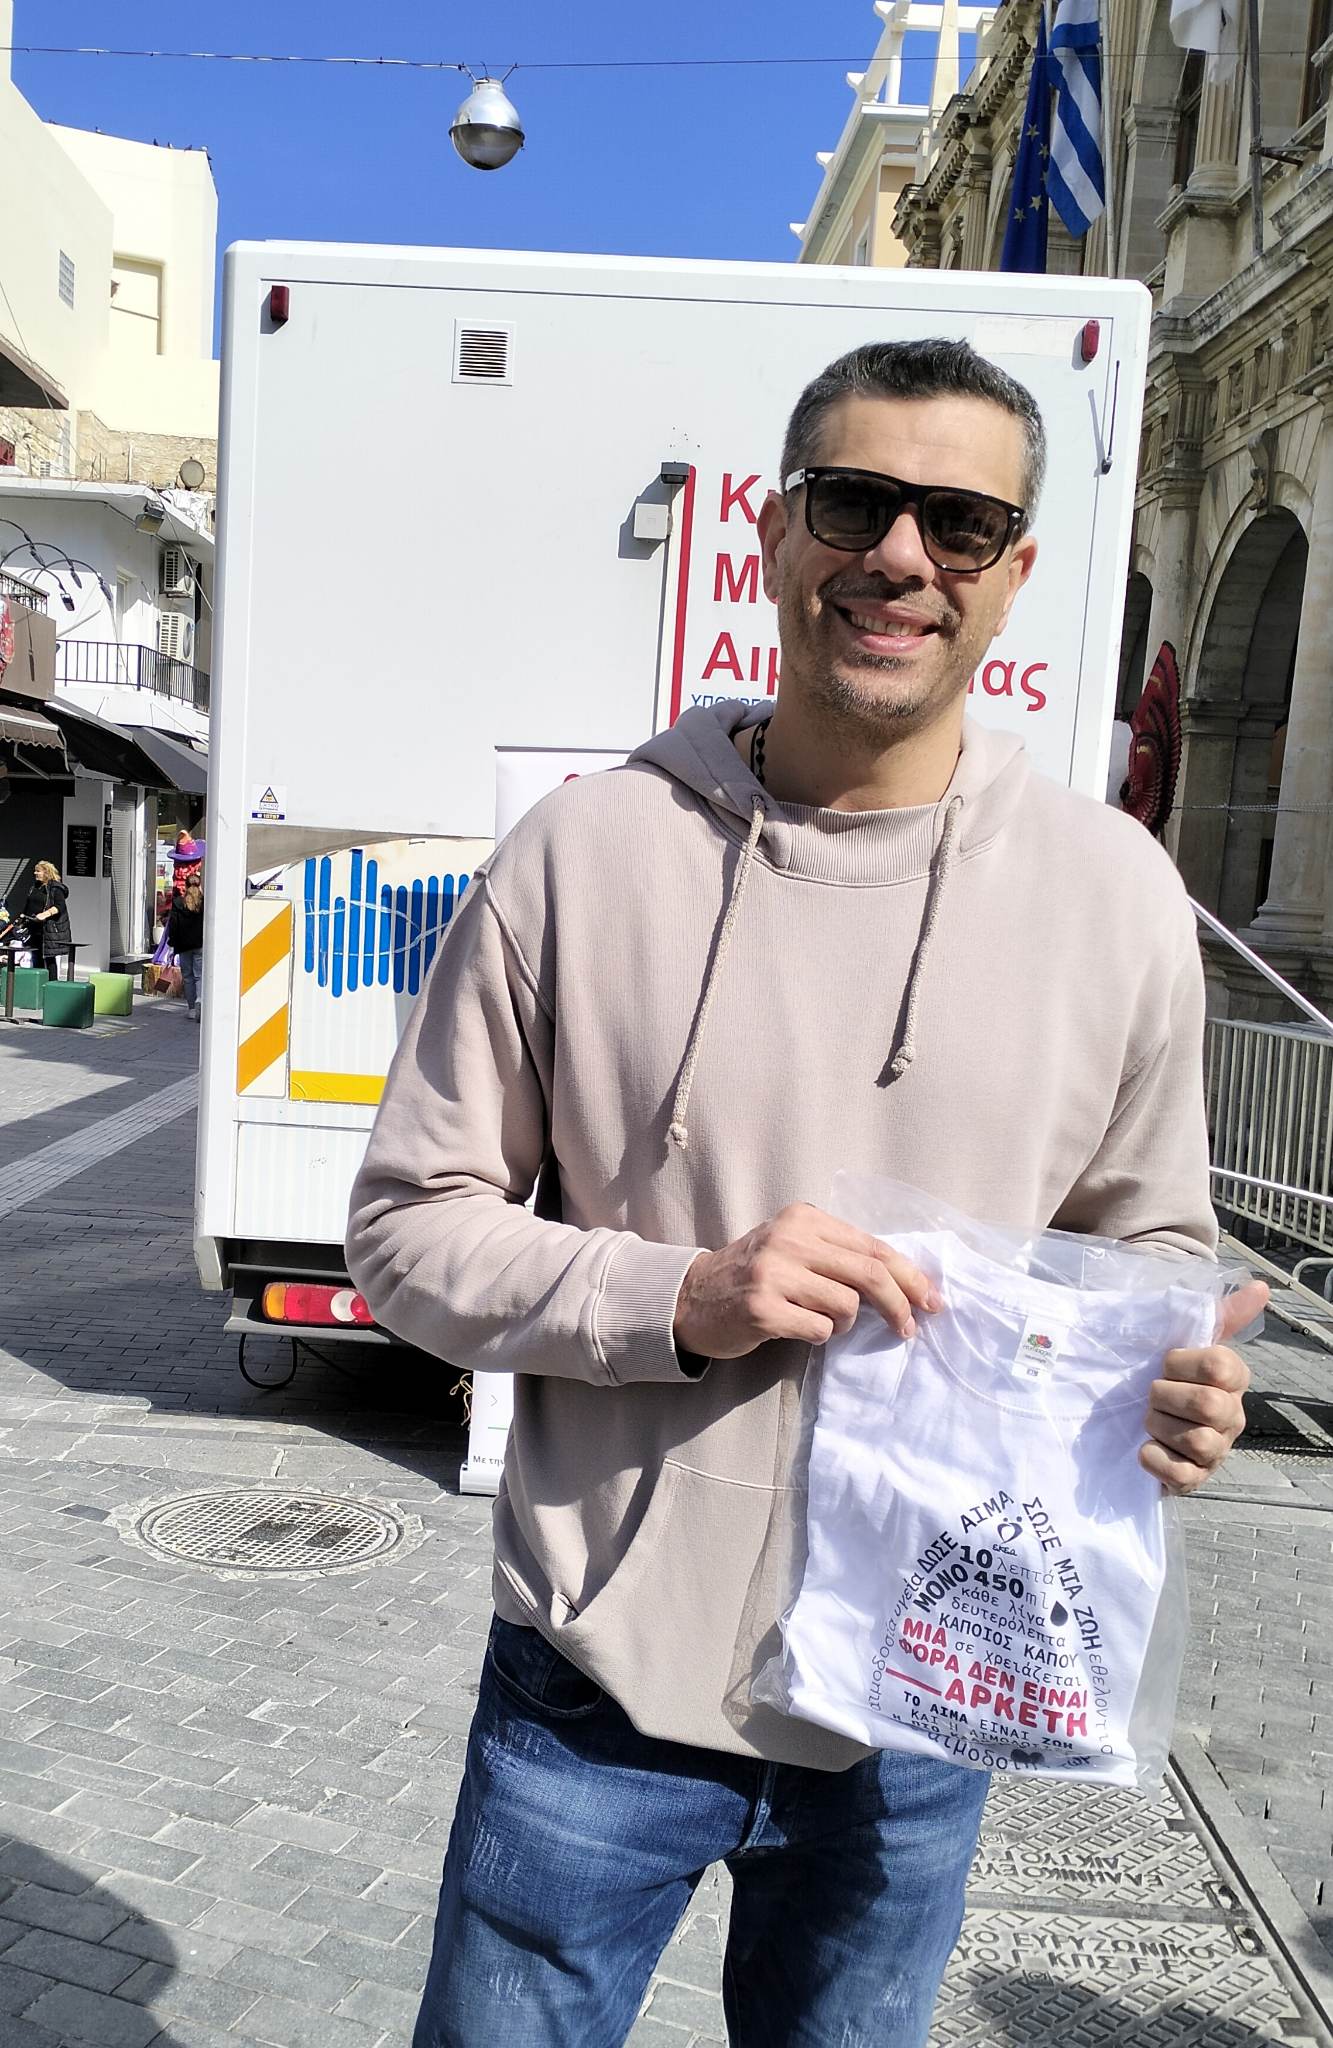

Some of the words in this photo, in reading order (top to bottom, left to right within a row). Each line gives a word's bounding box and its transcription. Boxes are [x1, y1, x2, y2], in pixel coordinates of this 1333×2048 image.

[894, 1572, 925, 1617] υγεία
[917, 1531, 958, 1574] ΔΩΣΕ
[960, 1490, 1014, 1534] ΑΙΜΑ
[1022, 1497, 1062, 1552] ΣΩΣΕ
[1054, 1558, 1083, 1600] ΜΙΑ
[1073, 1606, 1102, 1650] ΖΩΗ
[913, 1564, 968, 1613] ΜΟΝΟ
[960, 1546, 993, 1569] 10
[997, 1557, 1054, 1585] λεπτά
[962, 1587, 1000, 1606] κάθε
[1009, 1600, 1045, 1627] λίγα
[974, 1571, 1024, 1598] 450
[1026, 1592, 1048, 1609] ml
[903, 1618, 947, 1648] ΜΙΑ
[940, 1613, 1013, 1651] ΚΑΠΟΙΟΣ
[1024, 1643, 1078, 1668] ΚΑΠΟΥ
[952, 1597, 1066, 1647] δευτερόλεπτα
[956, 1642, 974, 1654] σε
[899, 1638, 959, 1673] ΦΟΡΑ
[968, 1661, 1015, 1692] ΔΕΝ
[1023, 1681, 1087, 1708] ΕΙΝΑΙ
[904, 1691, 920, 1706] ΤΟ
[930, 1704, 968, 1724] ΑΙΜΑ
[980, 1719, 1029, 1740] ΕΙΝΑΙ
[1042, 1737, 1073, 1749] ΖΩΗ
[912, 1709, 938, 1725] ΚΑΙ
[945, 1679, 1087, 1737] ΑΡΚΕΤΗ
[1021, 1851, 1119, 1870] ΔΙΚΤΥΟ
[1023, 1866, 1165, 1887] ΕΛΛΗΝΙΚΟ
[1013, 1932, 1214, 1959] ΕΥΡΥΖΩΝΙΚΟ
[1048, 1952, 1120, 1969] ΚΠΣ
